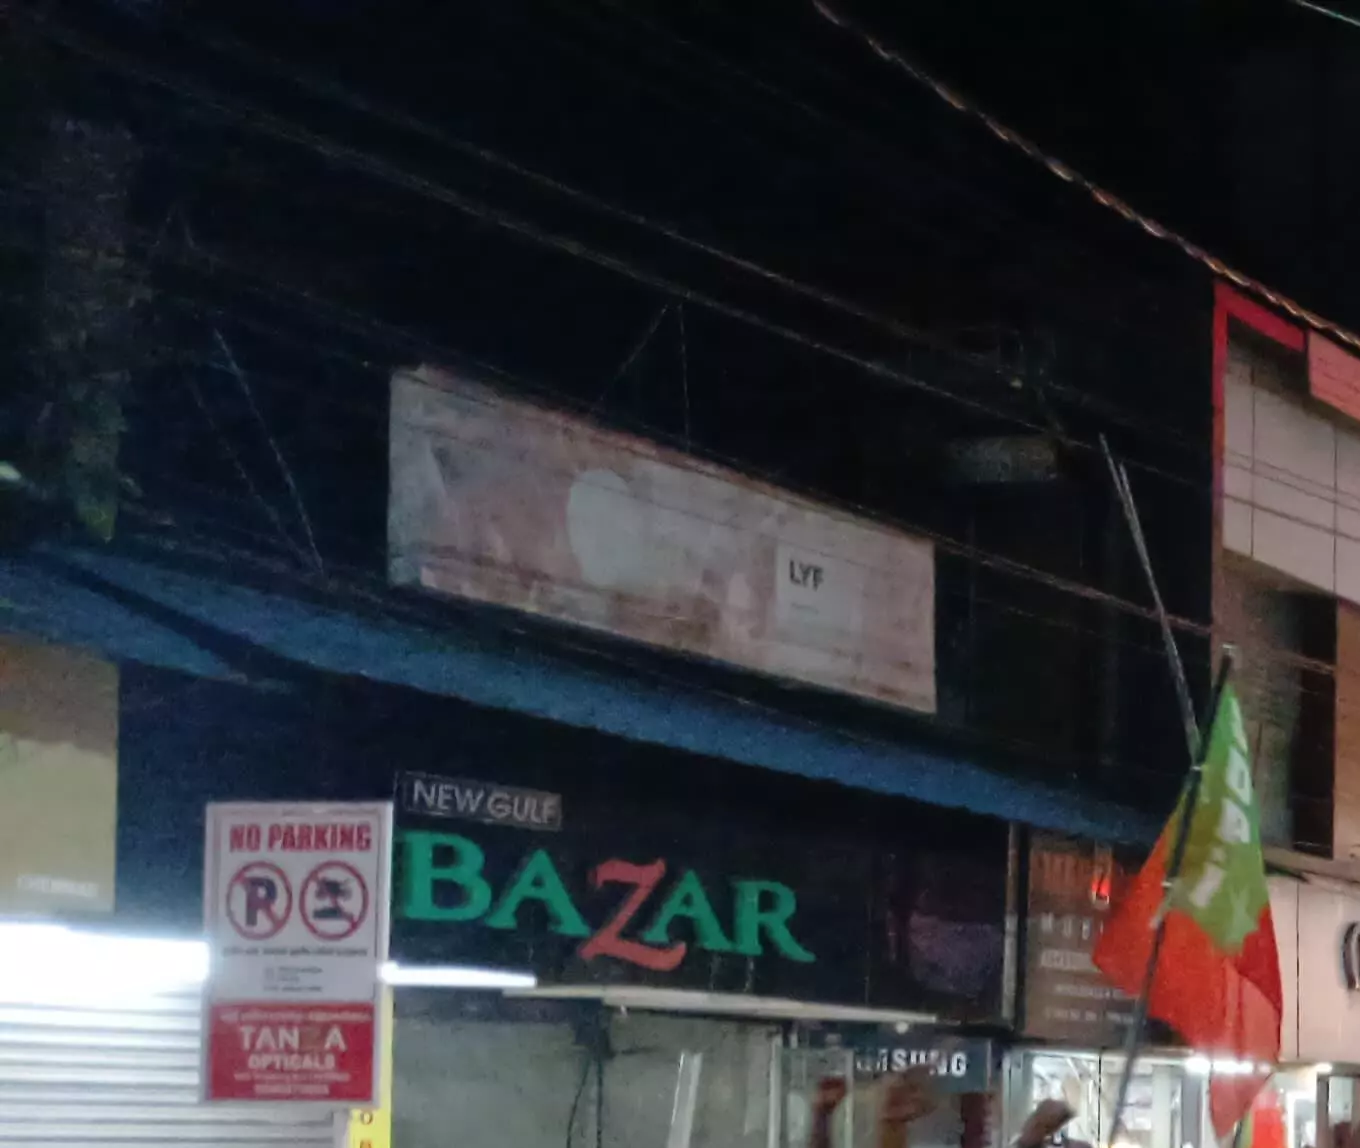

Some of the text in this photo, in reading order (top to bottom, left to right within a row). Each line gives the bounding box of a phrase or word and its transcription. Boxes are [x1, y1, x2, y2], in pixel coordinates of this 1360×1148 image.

[789, 560, 824, 592] LYF
[412, 779, 558, 825] NEW GULF
[230, 823, 371, 852] NO PARKING
[401, 830, 819, 970] BAZAR
[248, 1053, 336, 1070] OPTICALS
